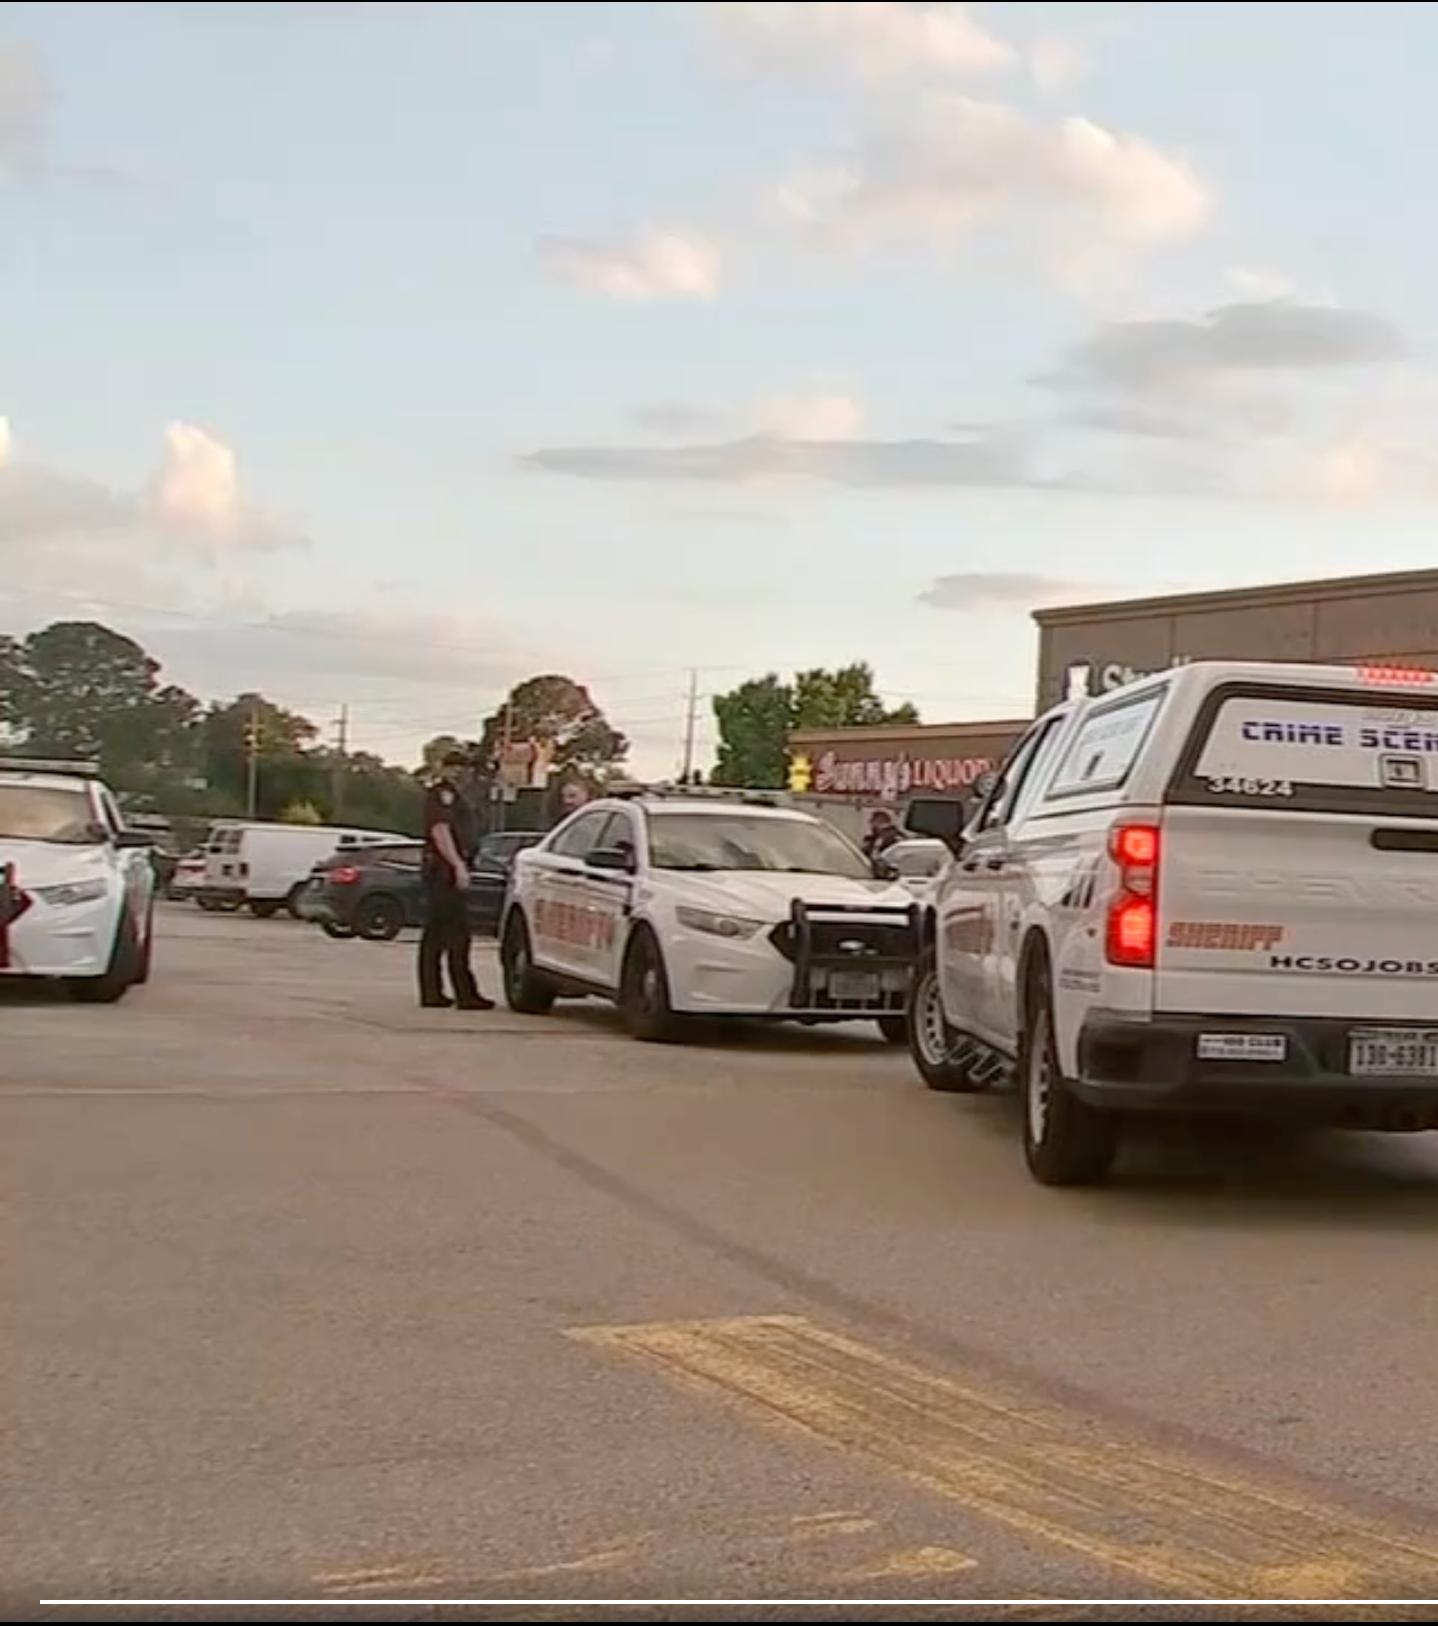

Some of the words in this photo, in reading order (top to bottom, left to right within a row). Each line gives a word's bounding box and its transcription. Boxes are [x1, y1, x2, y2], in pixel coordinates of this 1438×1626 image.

[1242, 722, 1344, 745] CRIME
[1207, 775, 1294, 796] 34624
[1165, 921, 1285, 951] SHERIFF
